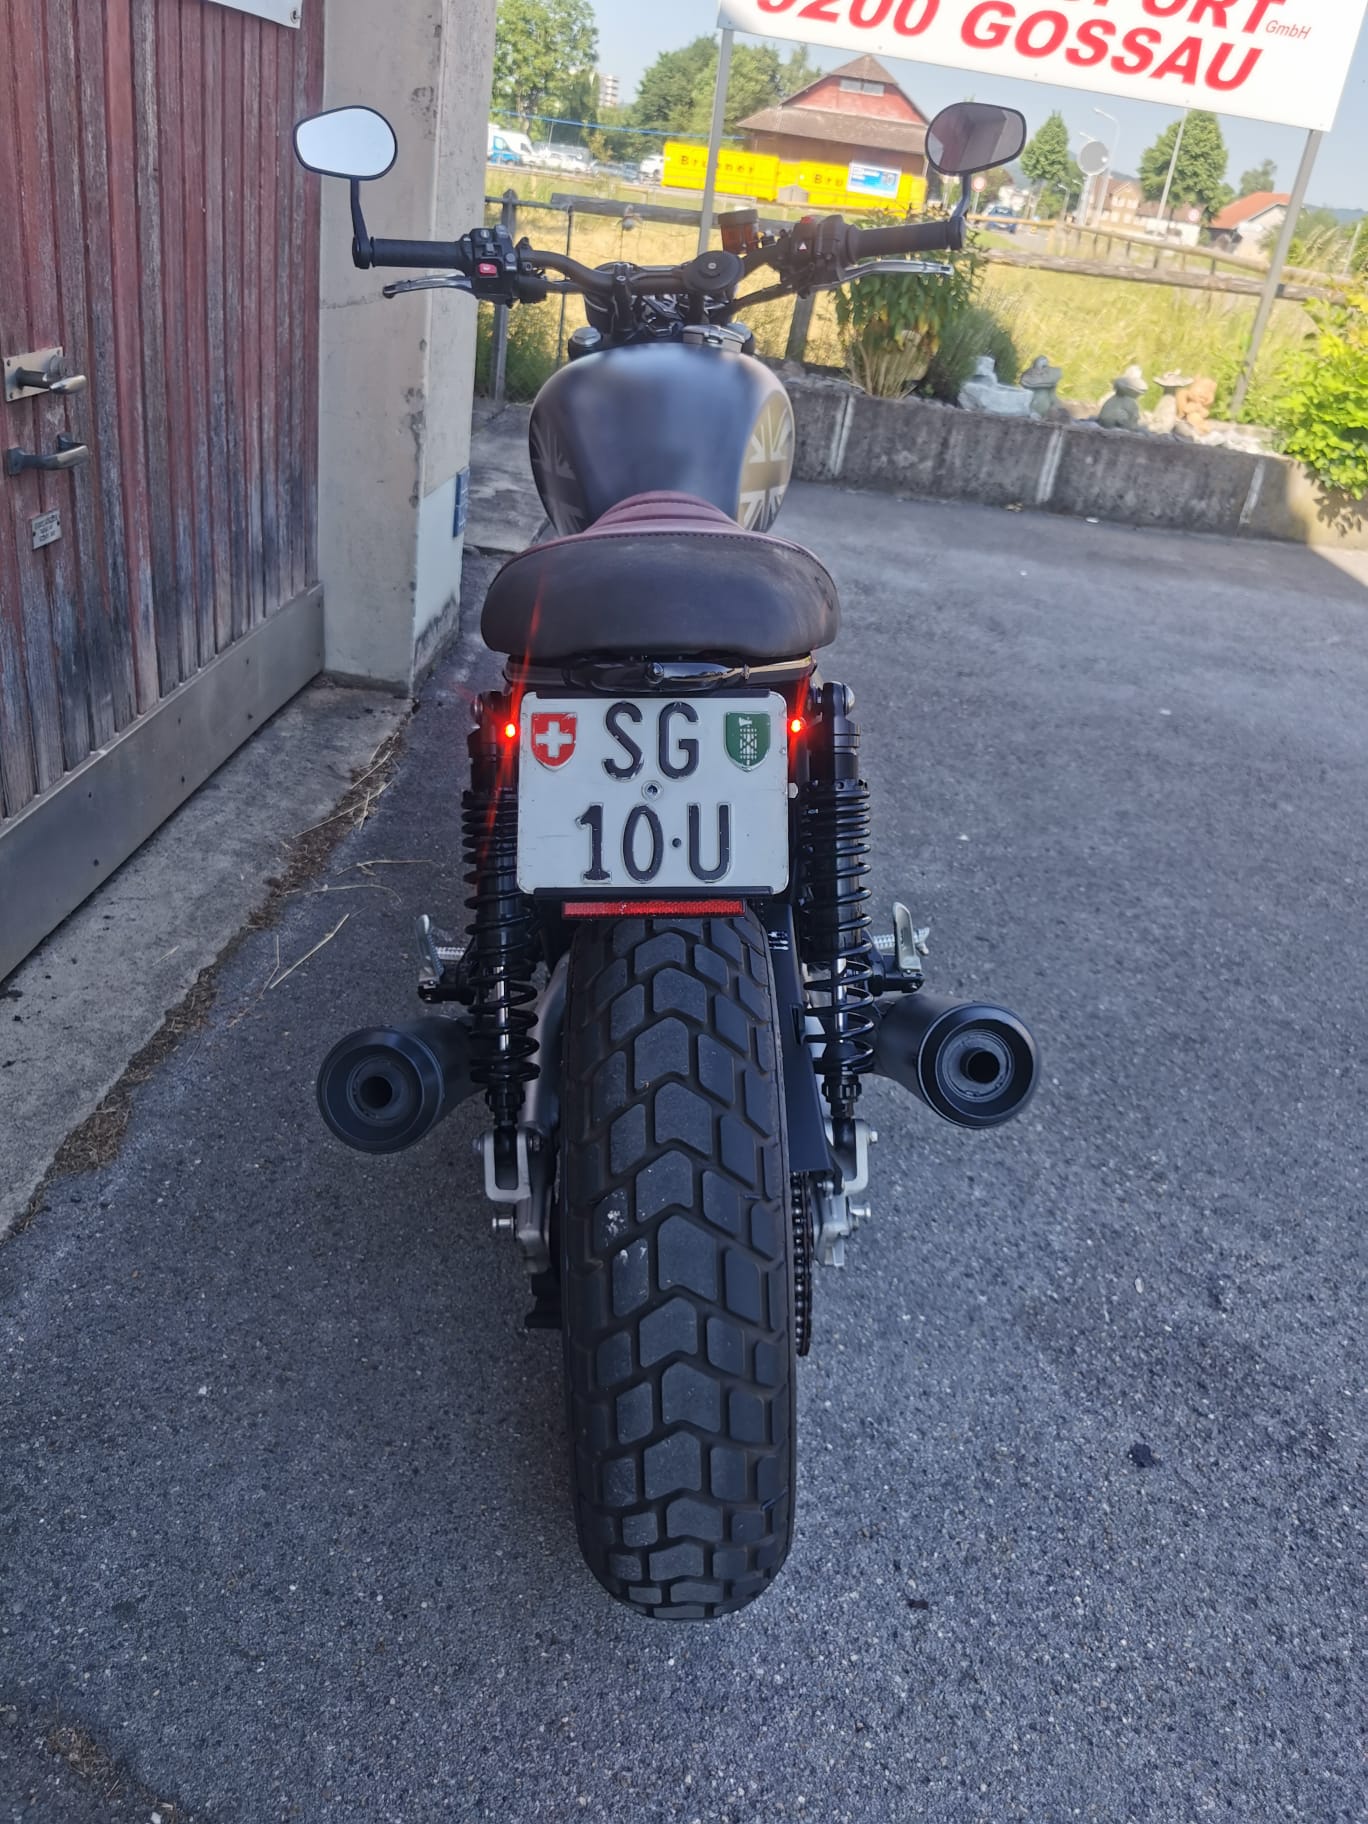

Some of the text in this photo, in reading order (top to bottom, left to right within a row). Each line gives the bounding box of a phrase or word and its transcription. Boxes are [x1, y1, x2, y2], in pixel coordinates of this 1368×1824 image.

[756, 0, 1264, 91] 200 GOSSAU
[1265, 20, 1312, 40] GmbH
[602, 701, 700, 781] SG
